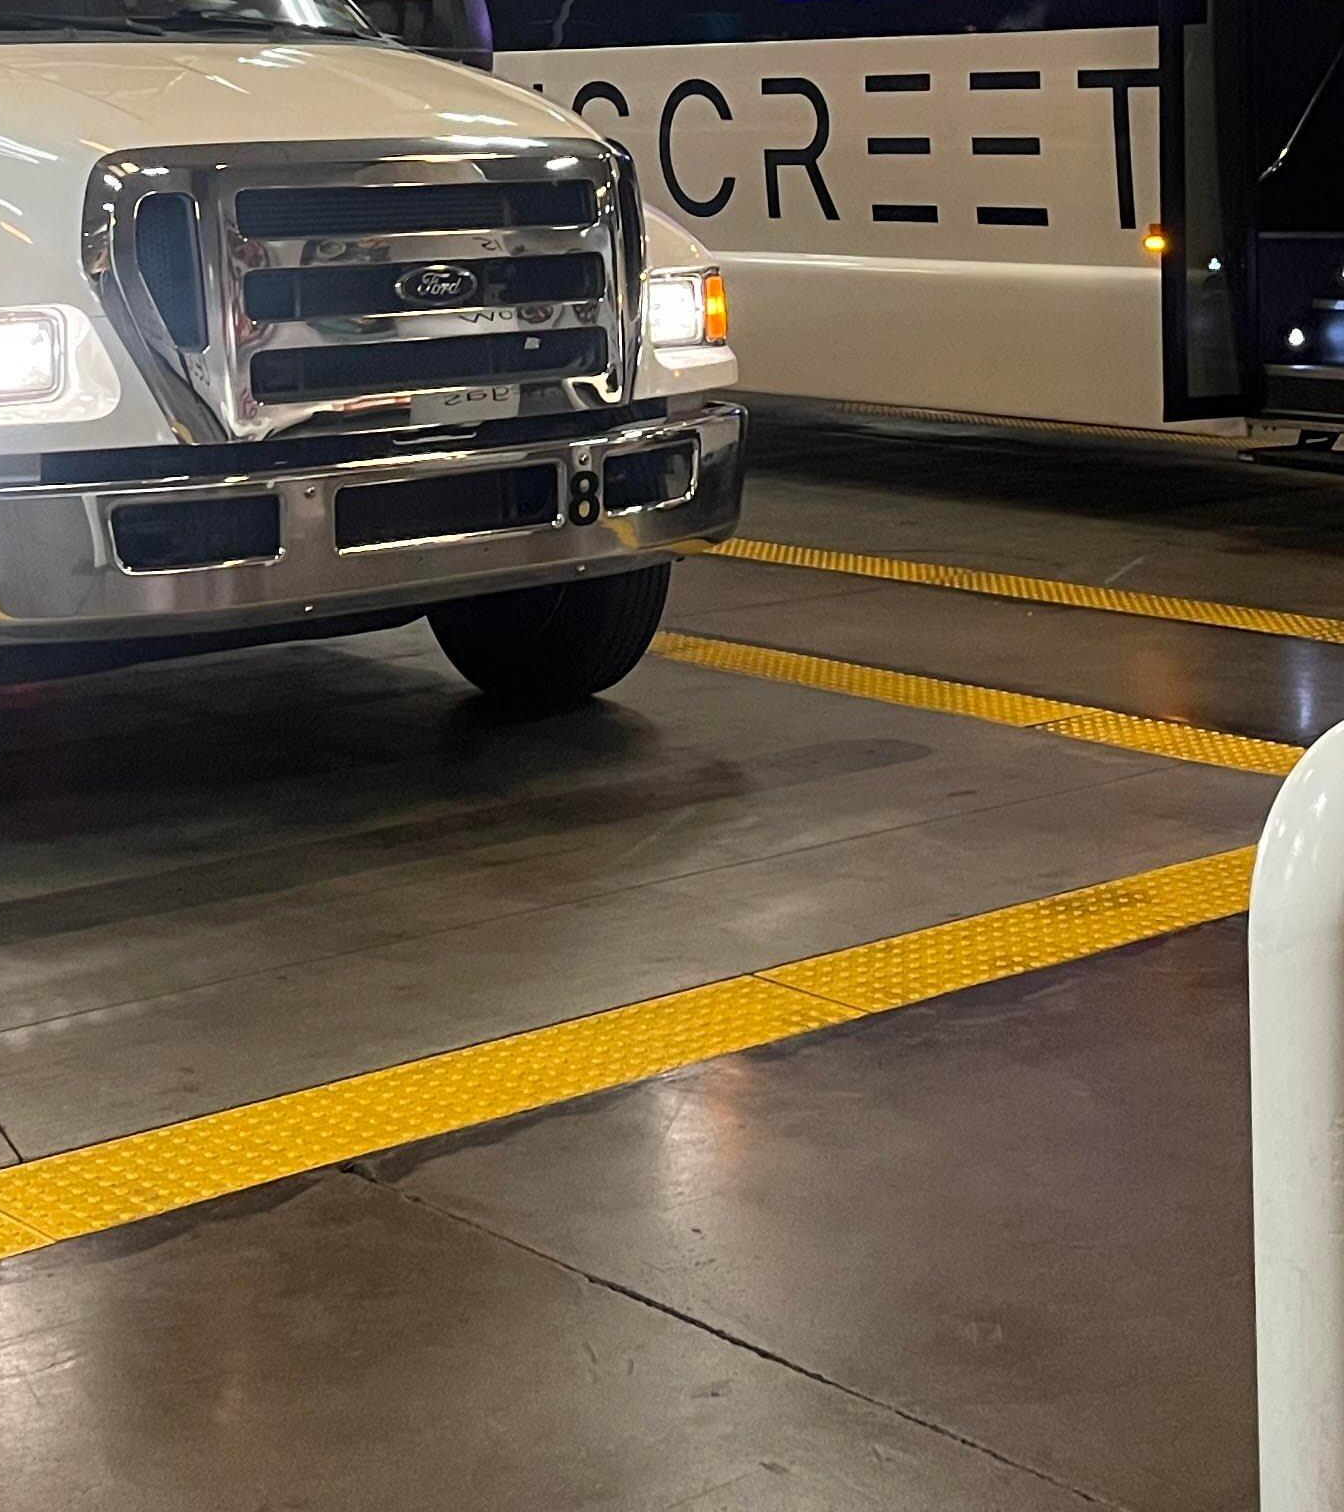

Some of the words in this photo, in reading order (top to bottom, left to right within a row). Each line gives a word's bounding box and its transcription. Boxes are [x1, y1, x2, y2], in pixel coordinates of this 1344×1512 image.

[533, 71, 1160, 229] CREET
[417, 271, 462, 296] Ford
[567, 471, 601, 527] 8
